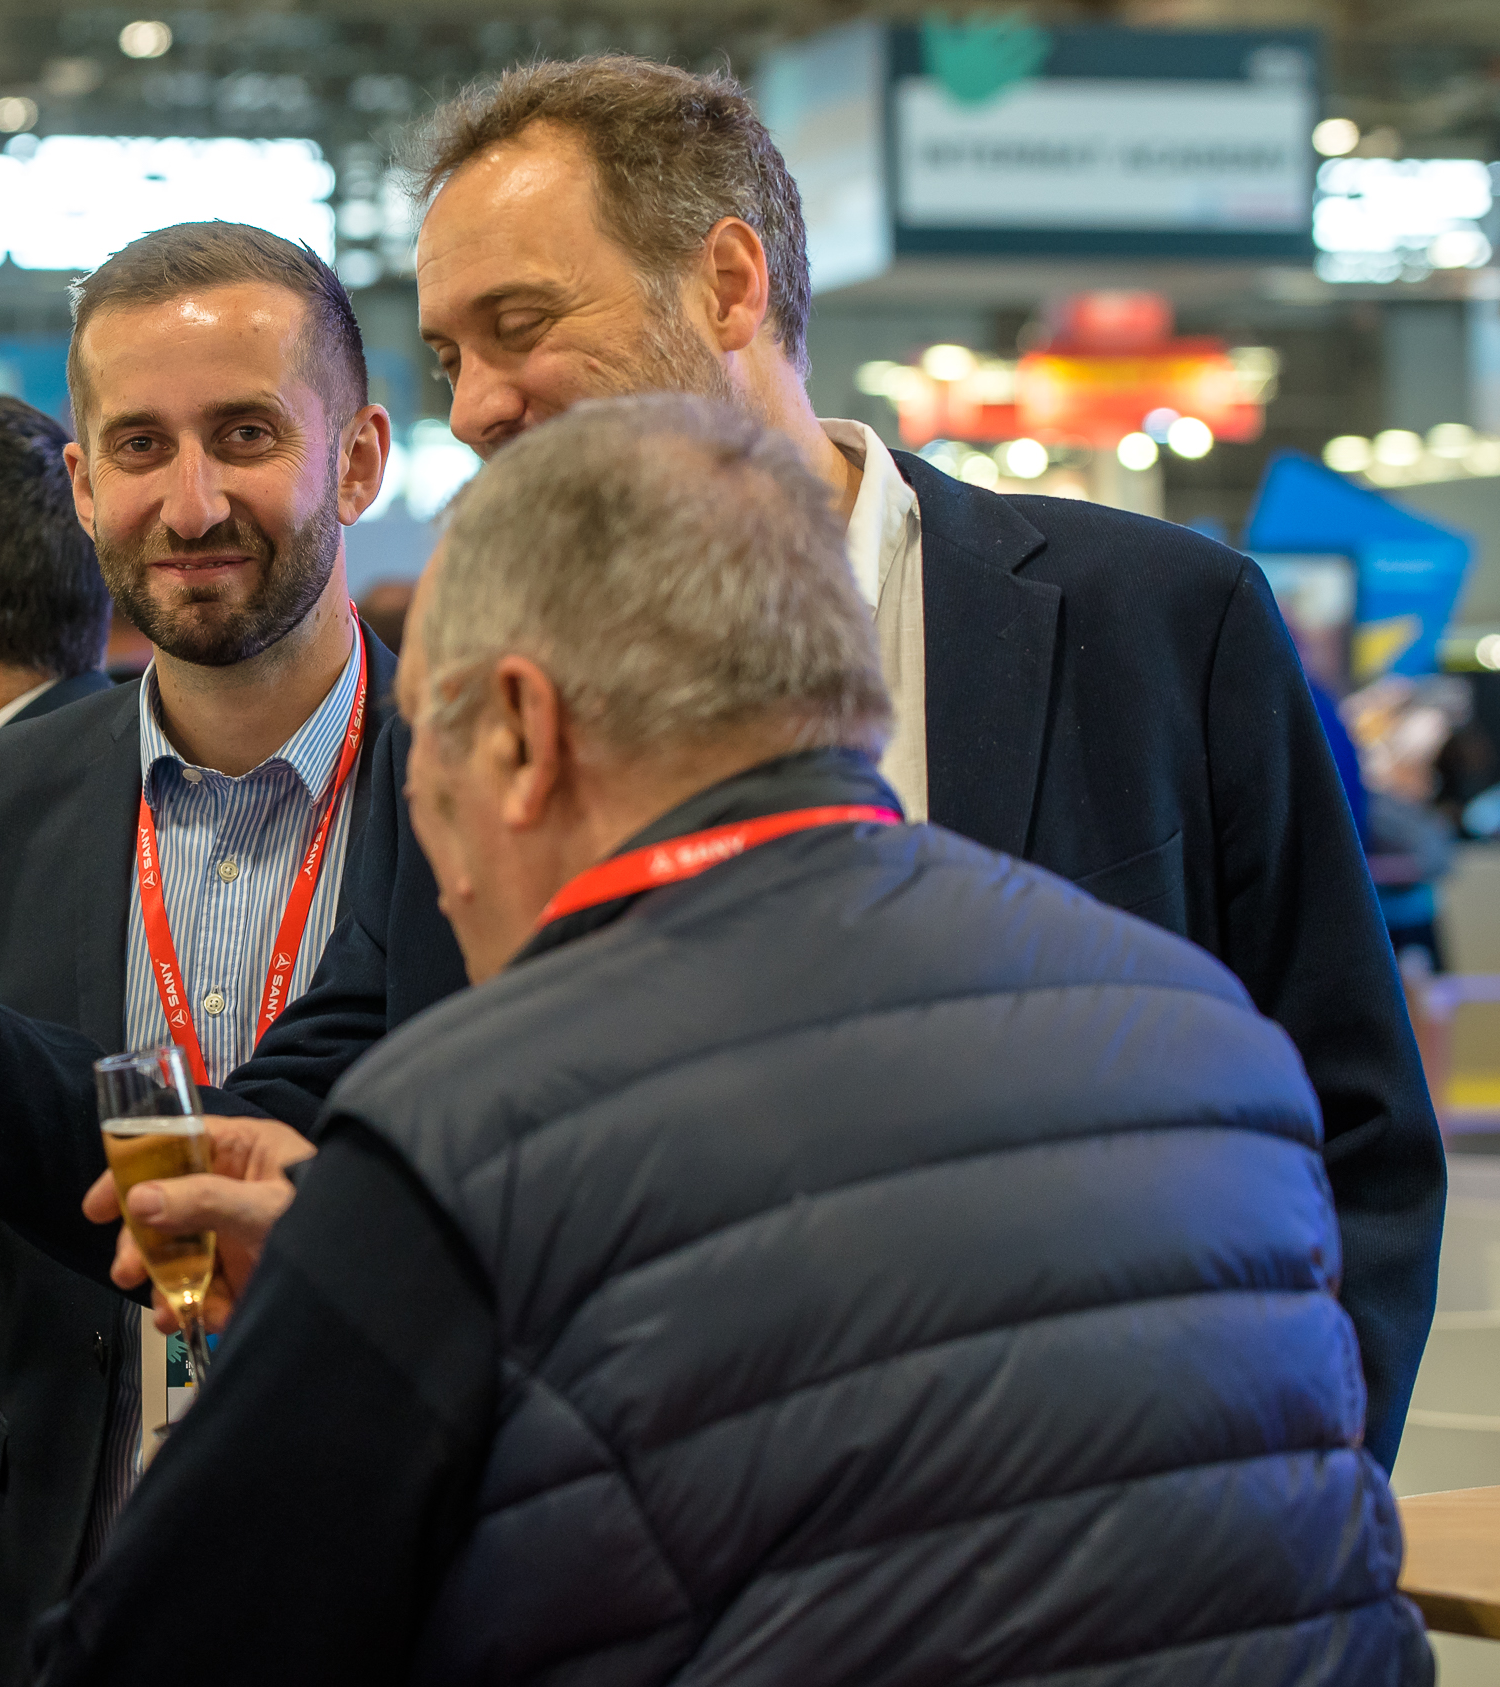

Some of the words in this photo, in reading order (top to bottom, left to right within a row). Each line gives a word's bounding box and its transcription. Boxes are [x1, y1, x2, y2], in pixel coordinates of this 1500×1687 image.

[353, 684, 366, 729] SANY
[140, 828, 153, 870] SANY
[303, 831, 323, 875] SANY
[159, 962, 180, 1007] SANY
[265, 974, 284, 1023] SANY
